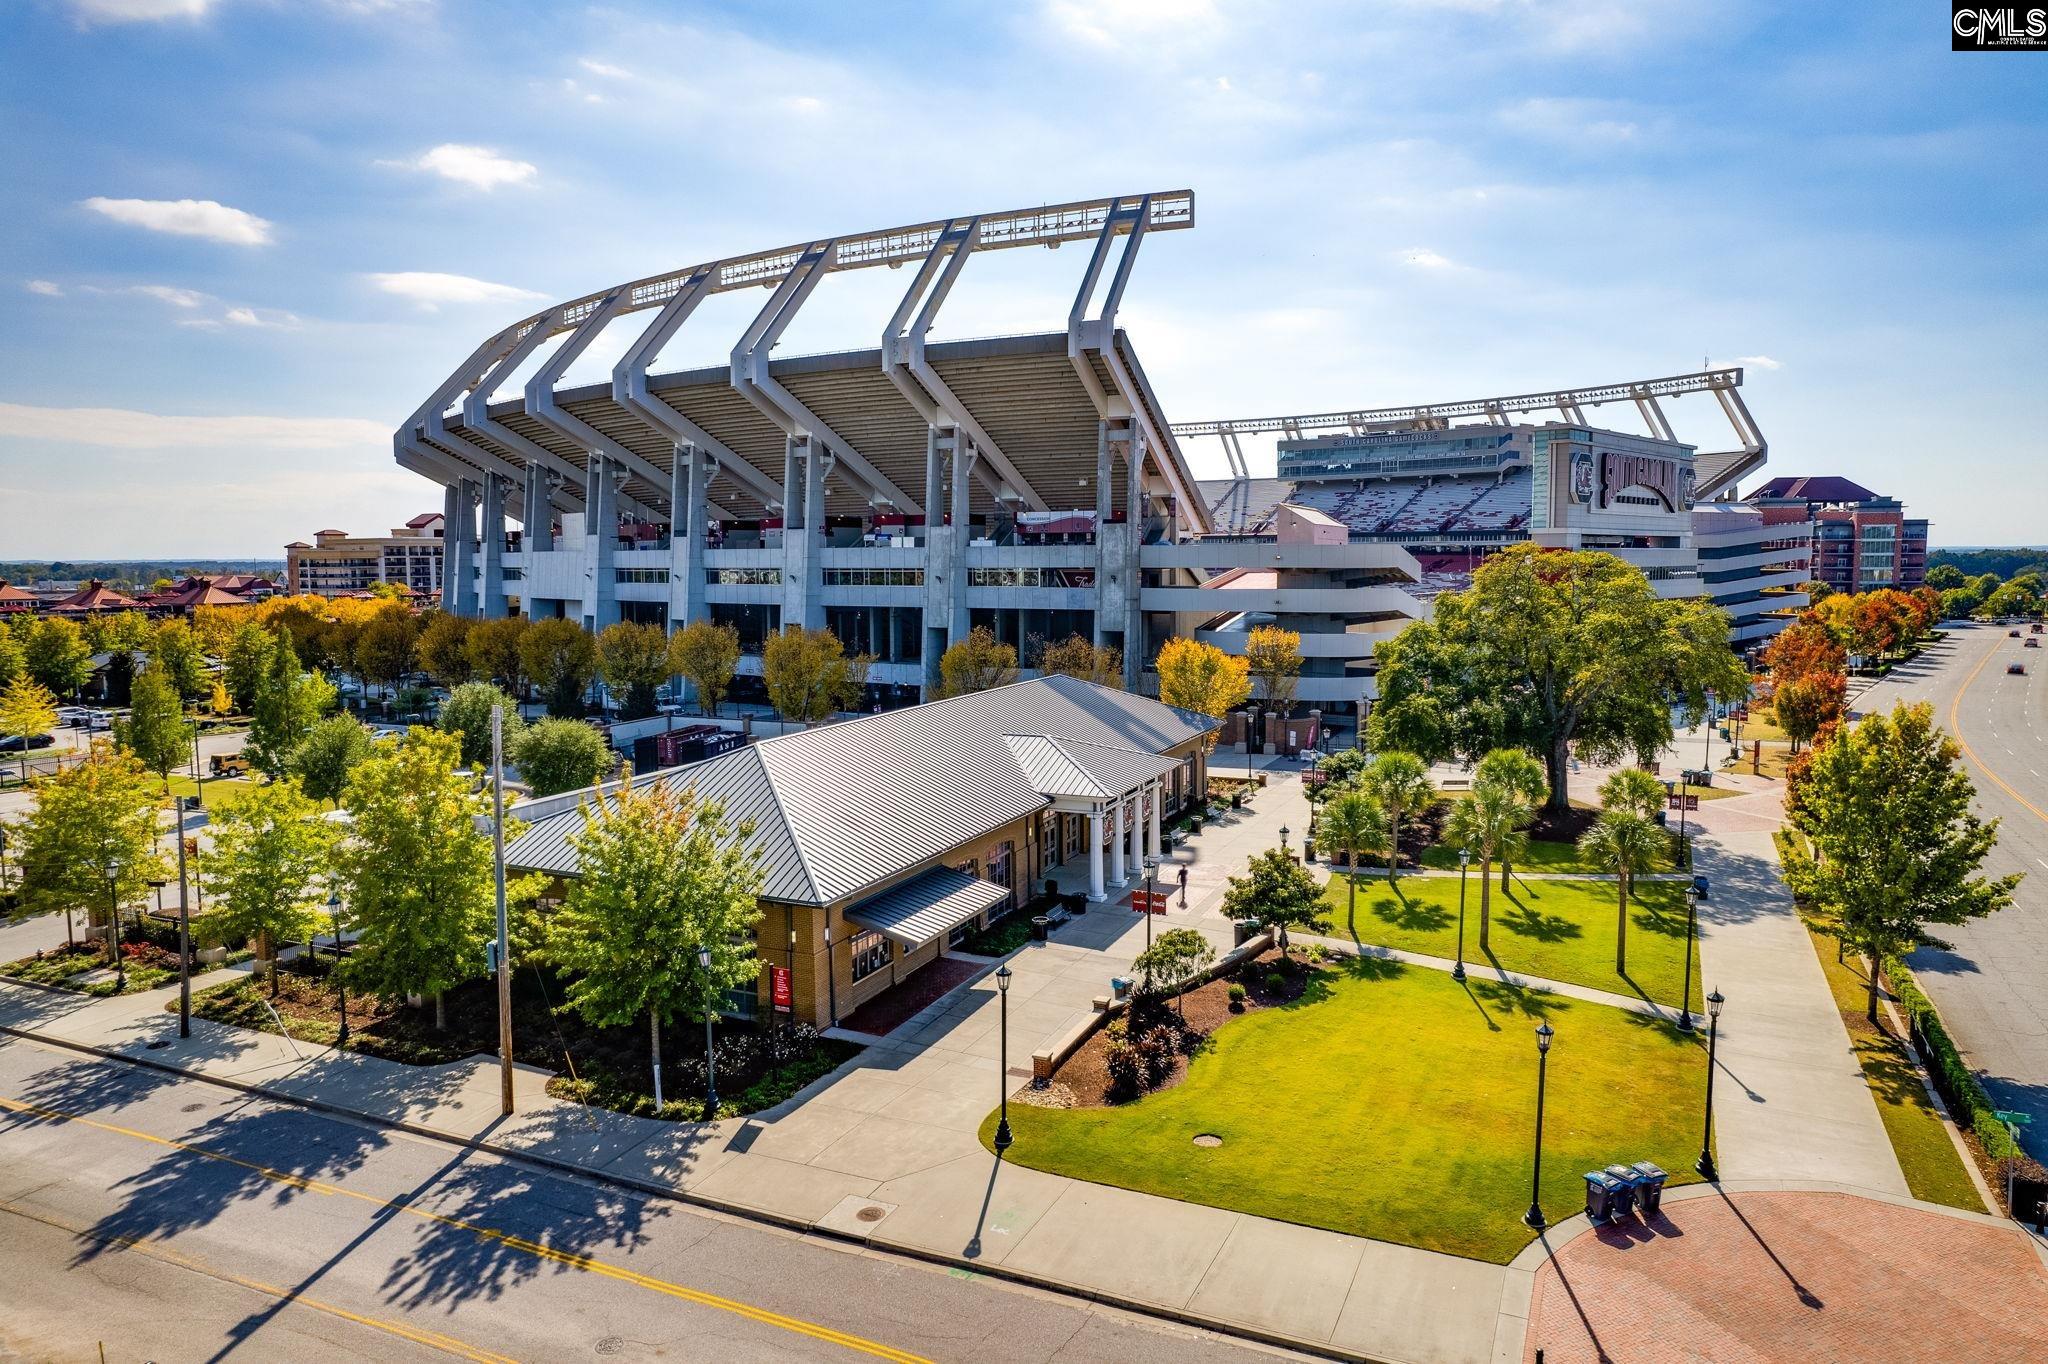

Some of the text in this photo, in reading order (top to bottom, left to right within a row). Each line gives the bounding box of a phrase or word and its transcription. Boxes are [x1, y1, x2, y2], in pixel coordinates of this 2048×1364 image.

[1604, 453, 1637, 509] SOUTH
[1074, 575, 1096, 588] Trad
[1996, 1112, 2008, 1121] Key
